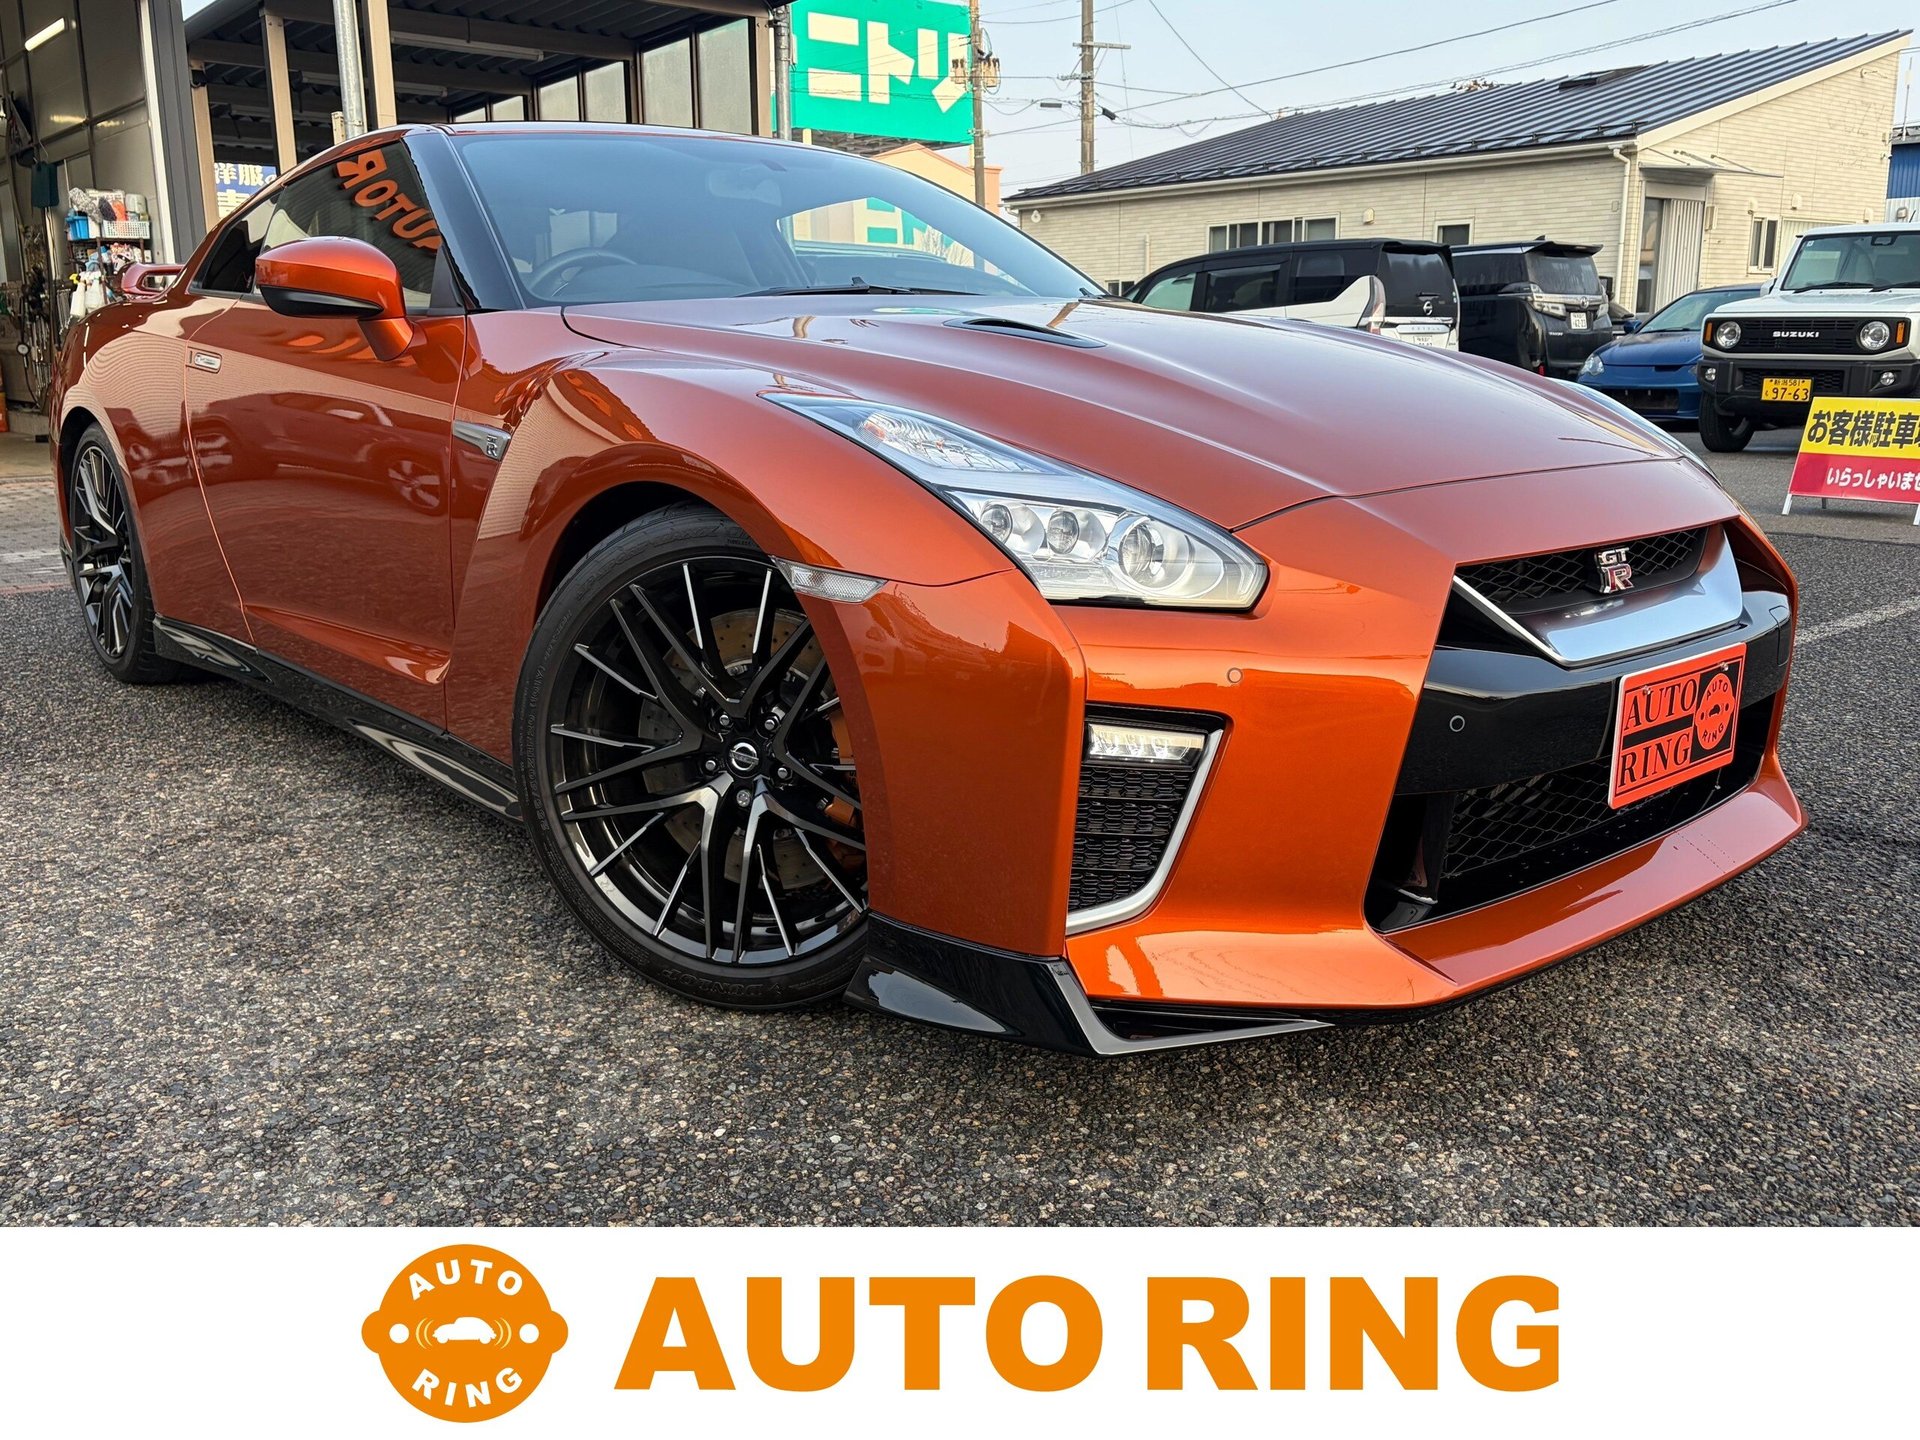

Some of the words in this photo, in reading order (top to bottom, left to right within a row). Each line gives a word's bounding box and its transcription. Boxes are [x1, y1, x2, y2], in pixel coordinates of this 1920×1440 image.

[807, 11, 967, 114] ニトリ
[1772, 330, 1820, 338] SUZUKI
[1771, 387, 1810, 400] 97-63
[1706, 680, 1729, 701] AUTO
[1623, 678, 1698, 731] AUTO
[1702, 724, 1724, 744] RING
[1617, 732, 1690, 788] RING
